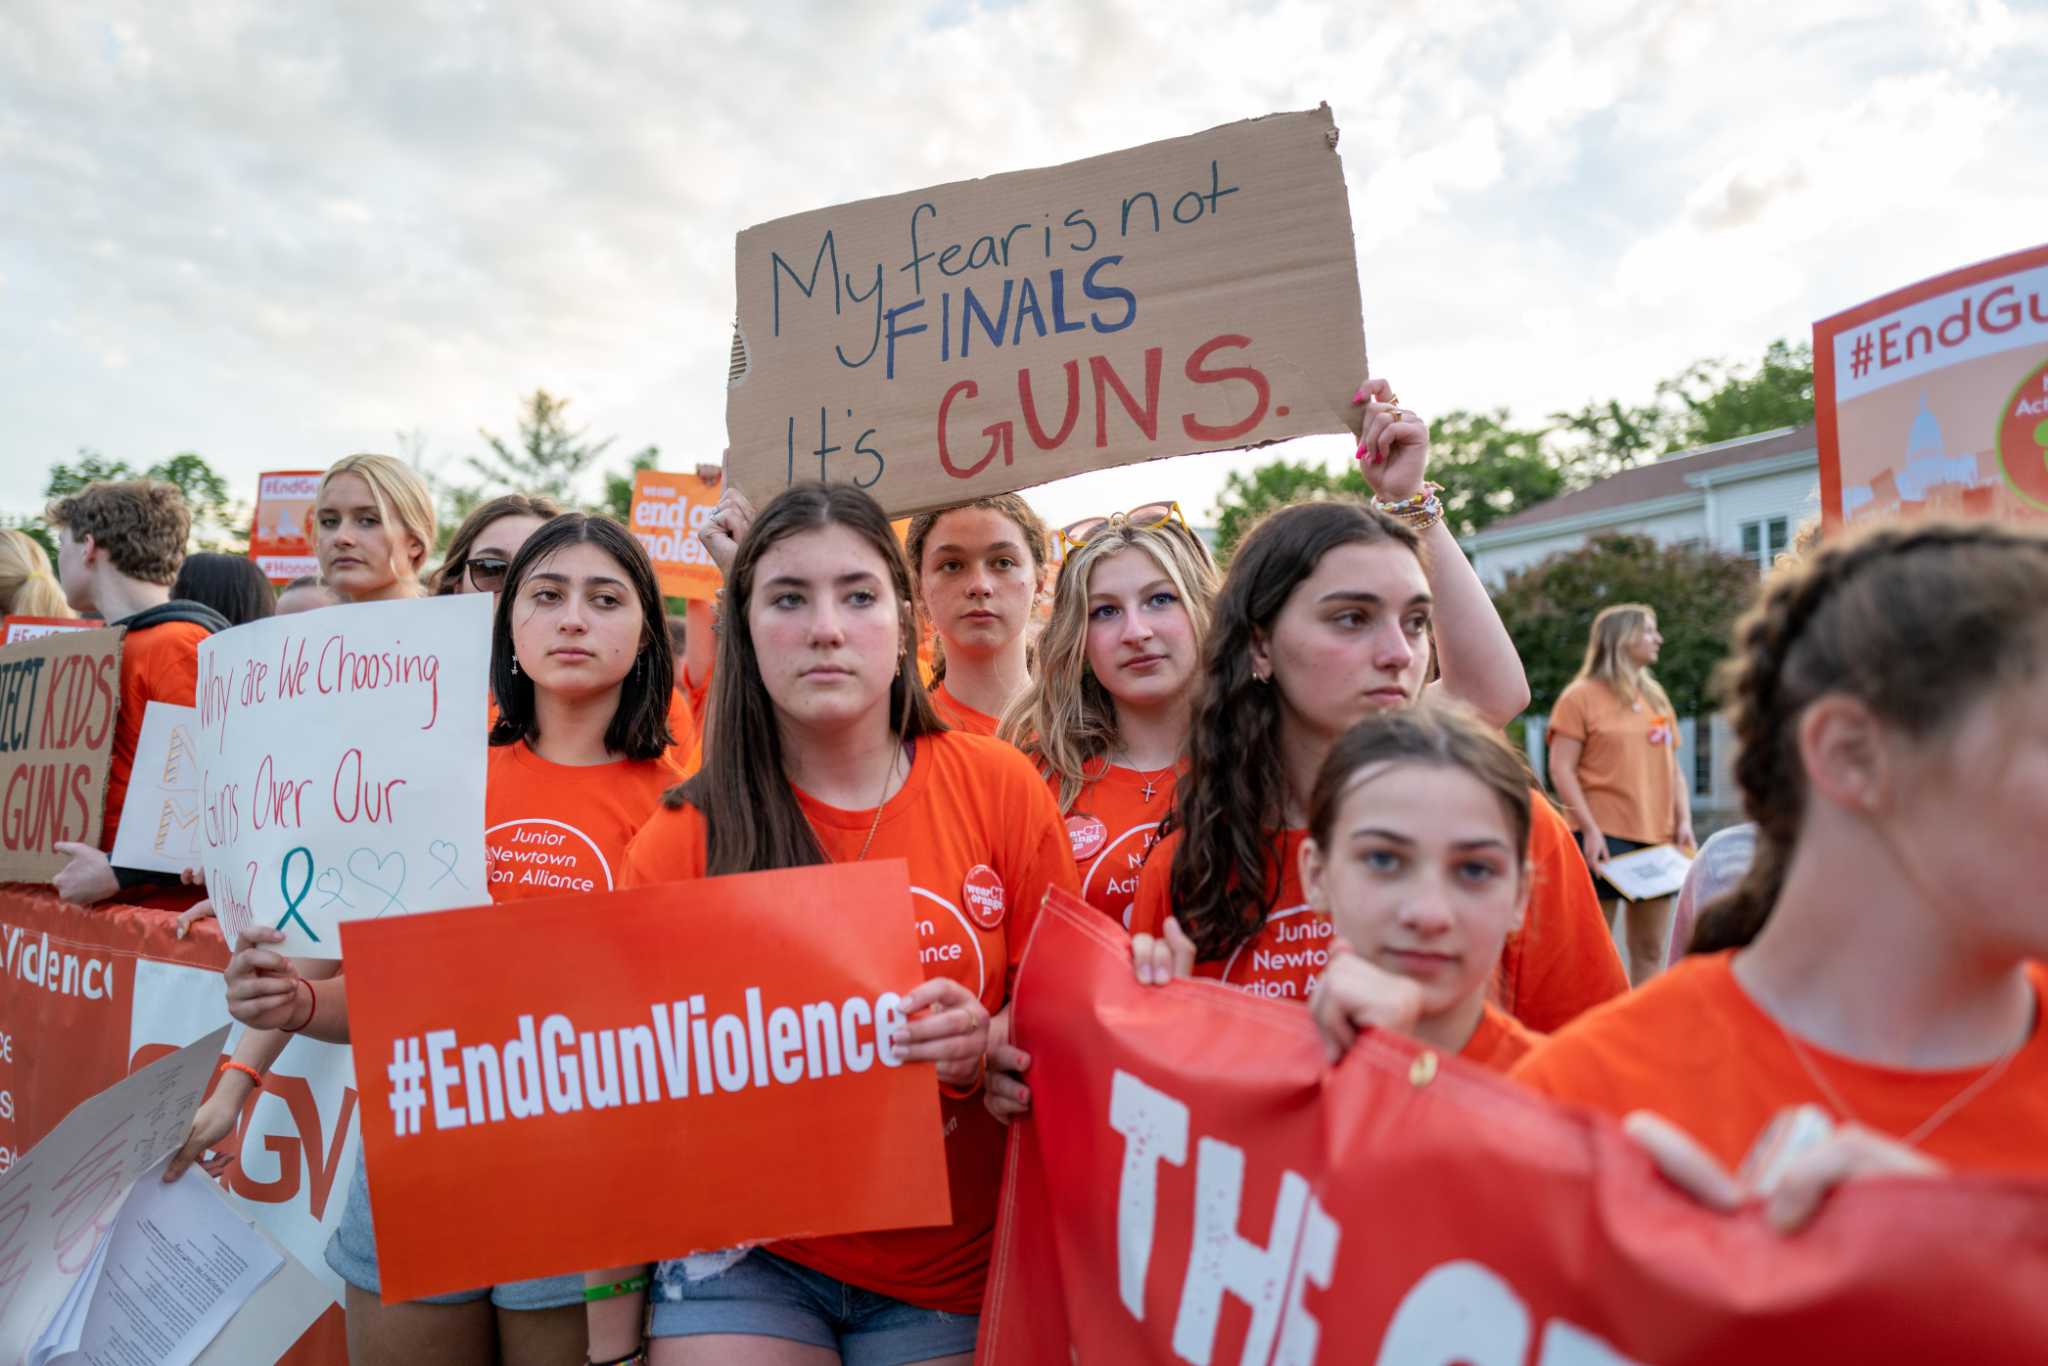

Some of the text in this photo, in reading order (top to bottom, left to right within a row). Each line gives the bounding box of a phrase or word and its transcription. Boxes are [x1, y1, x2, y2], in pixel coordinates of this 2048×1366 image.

[771, 159, 1240, 369] My fear is not
[882, 254, 1138, 381] FINALS
[786, 333, 1292, 490] It's GUNS.
[636, 496, 687, 529] end
[40, 654, 116, 750] KIDS
[240, 658, 268, 707] are
[278, 635, 310, 700] We
[317, 634, 440, 731] Choosing
[2, 761, 92, 855] GUNS
[252, 753, 313, 830] Over
[332, 747, 408, 824] Our
[511, 827, 566, 846] Junior
[519, 868, 594, 893] Alliance
[1106, 876, 1140, 896] Acti
[1252, 949, 1328, 971] Newto
[1275, 918, 1331, 943] Junio
[387, 986, 909, 1136] #EndGunViolence
